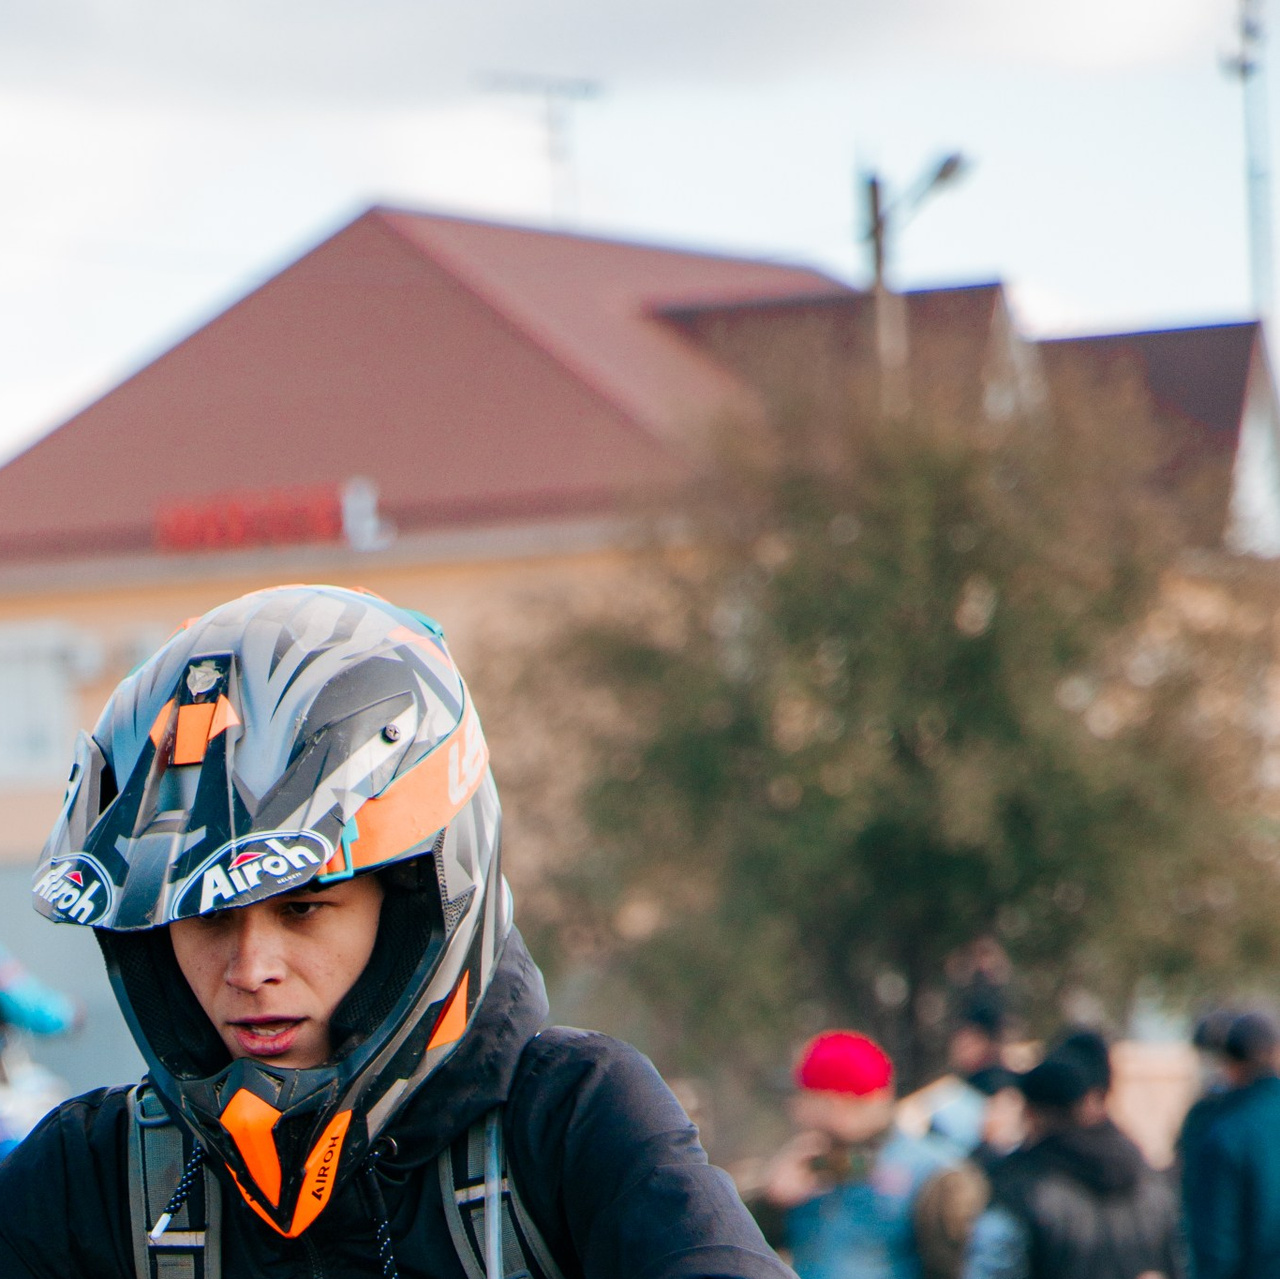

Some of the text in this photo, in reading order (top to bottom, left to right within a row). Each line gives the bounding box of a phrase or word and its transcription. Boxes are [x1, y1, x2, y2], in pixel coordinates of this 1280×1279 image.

[32, 863, 101, 924] Airoh
[200, 838, 320, 914] Airoh
[311, 1136, 339, 1201] AIROH
